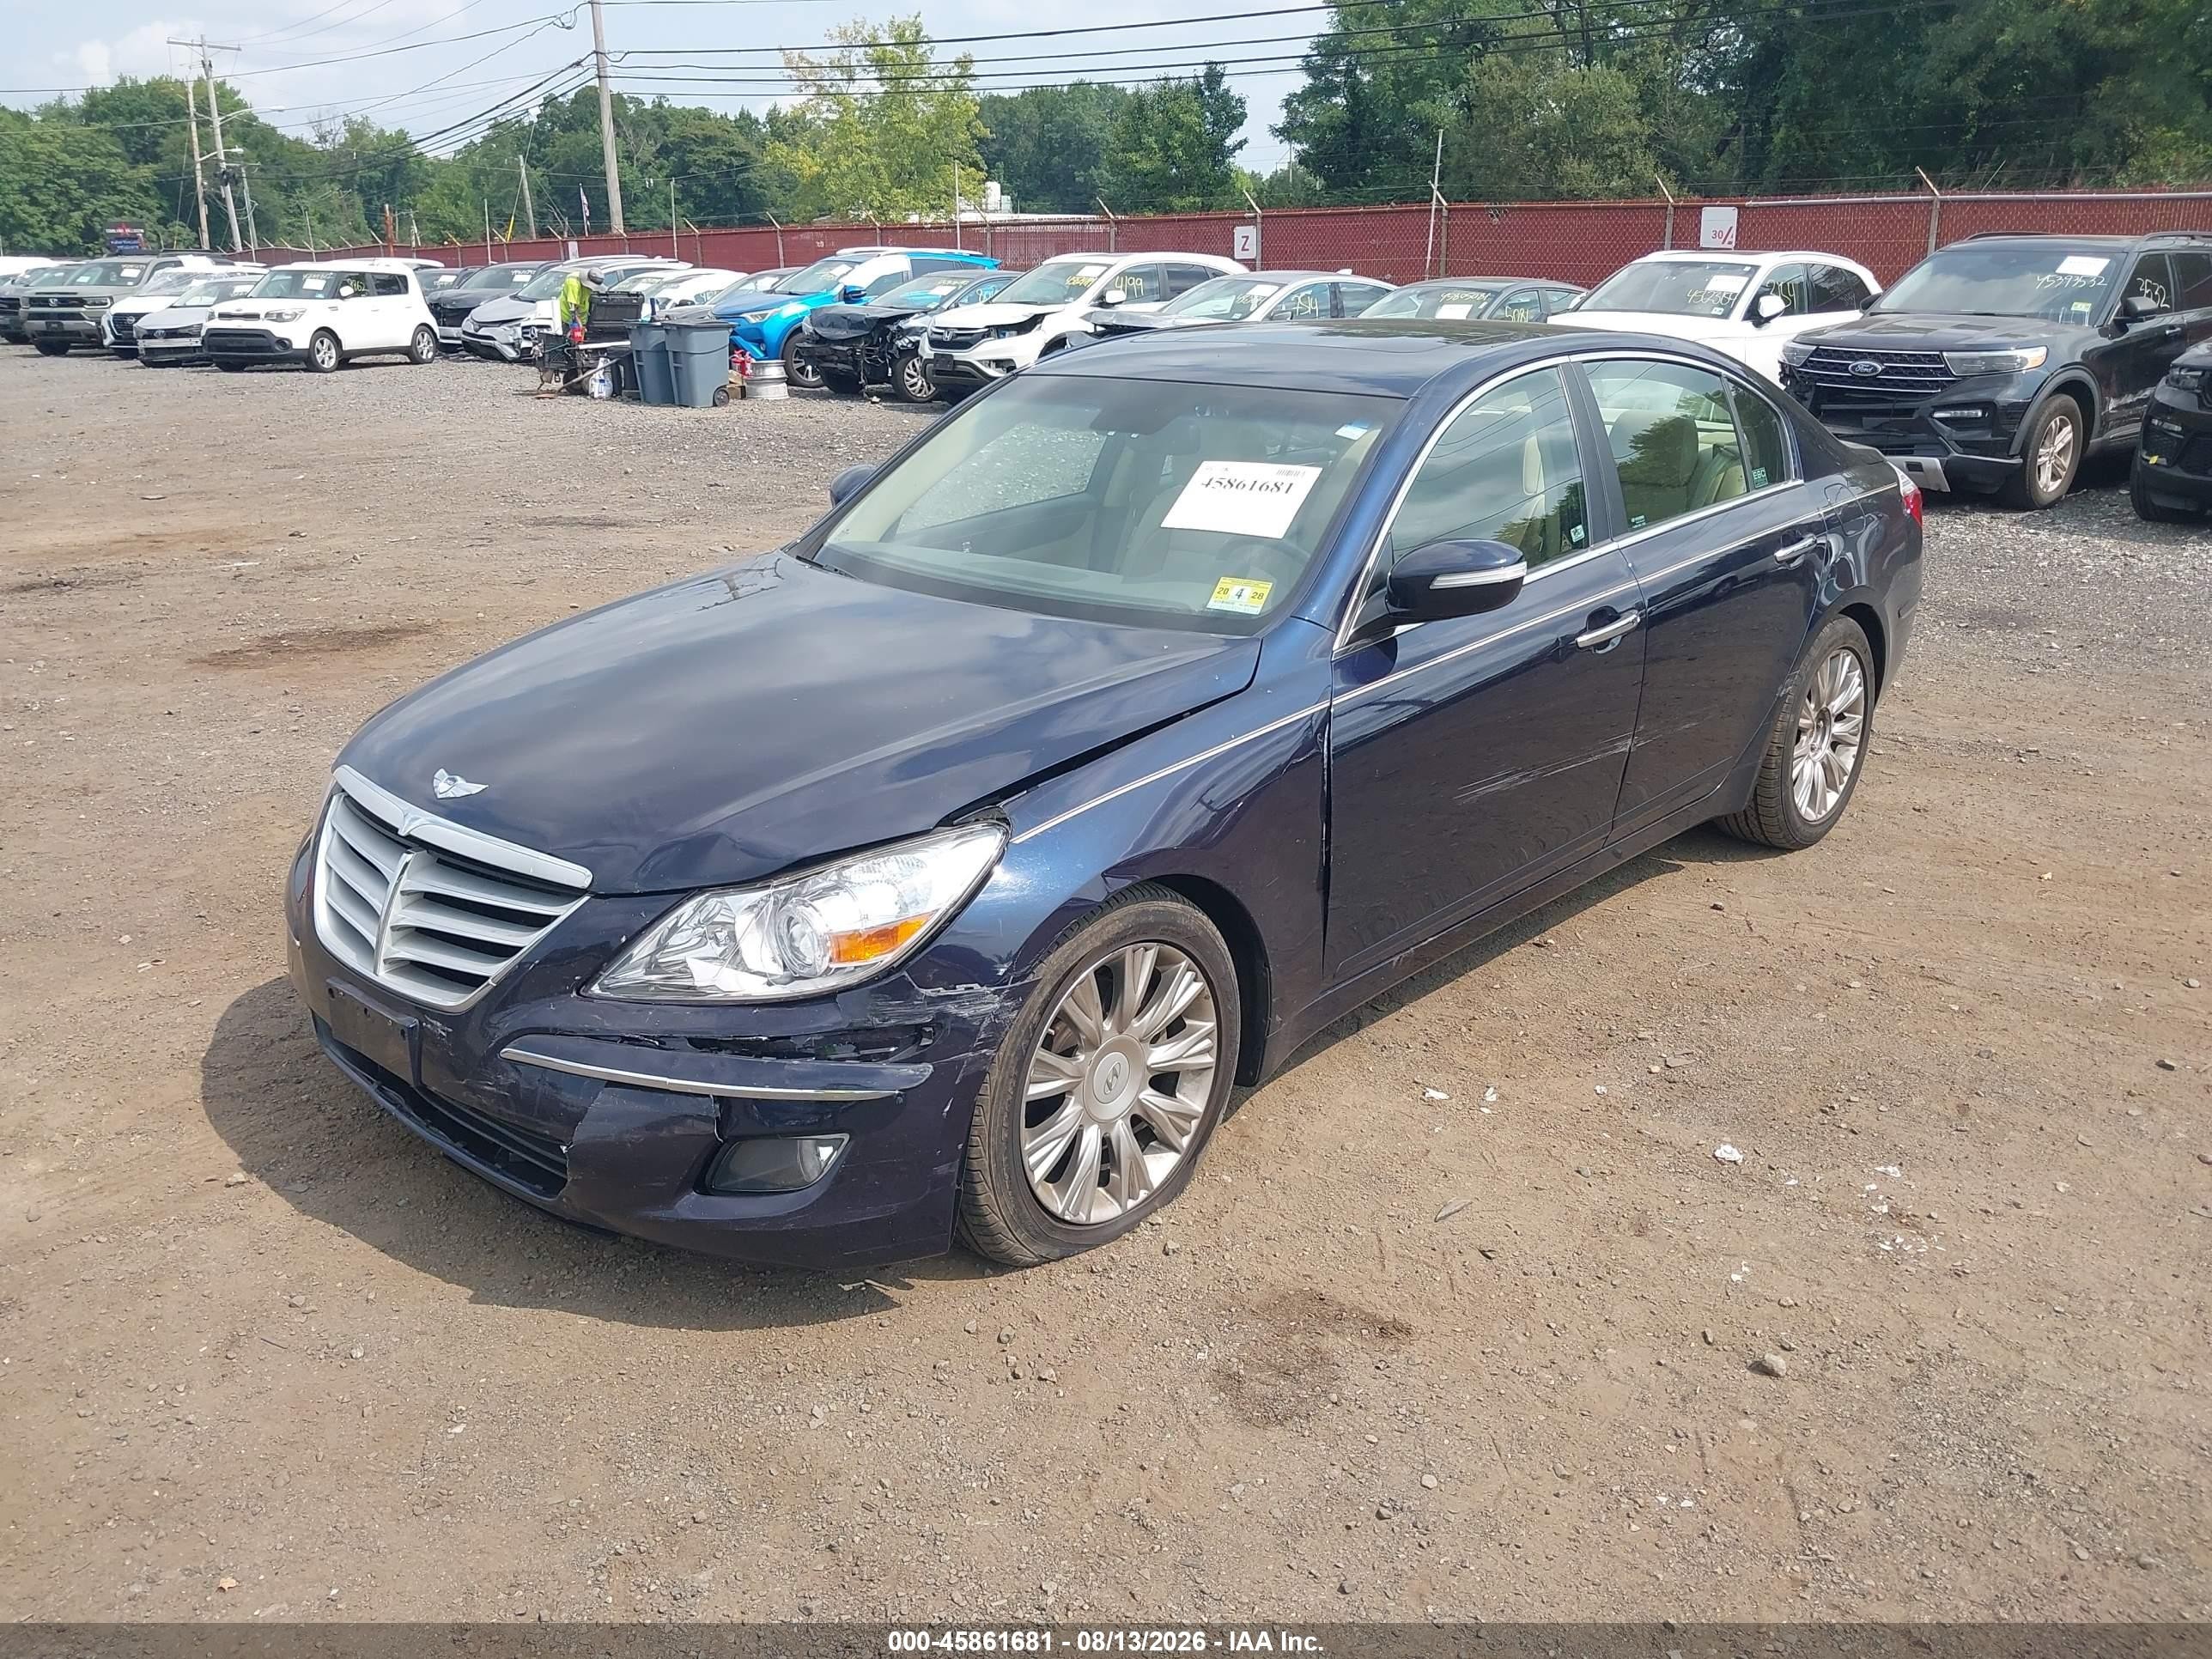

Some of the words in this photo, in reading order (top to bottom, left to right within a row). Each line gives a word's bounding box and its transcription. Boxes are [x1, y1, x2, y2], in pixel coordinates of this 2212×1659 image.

[1241, 234, 1249, 252] Z
[1115, 275, 1144, 298] 4199
[1201, 477, 1294, 495] 45861681
[1217, 586, 1230, 595] 20
[1236, 588, 1245, 599] 4
